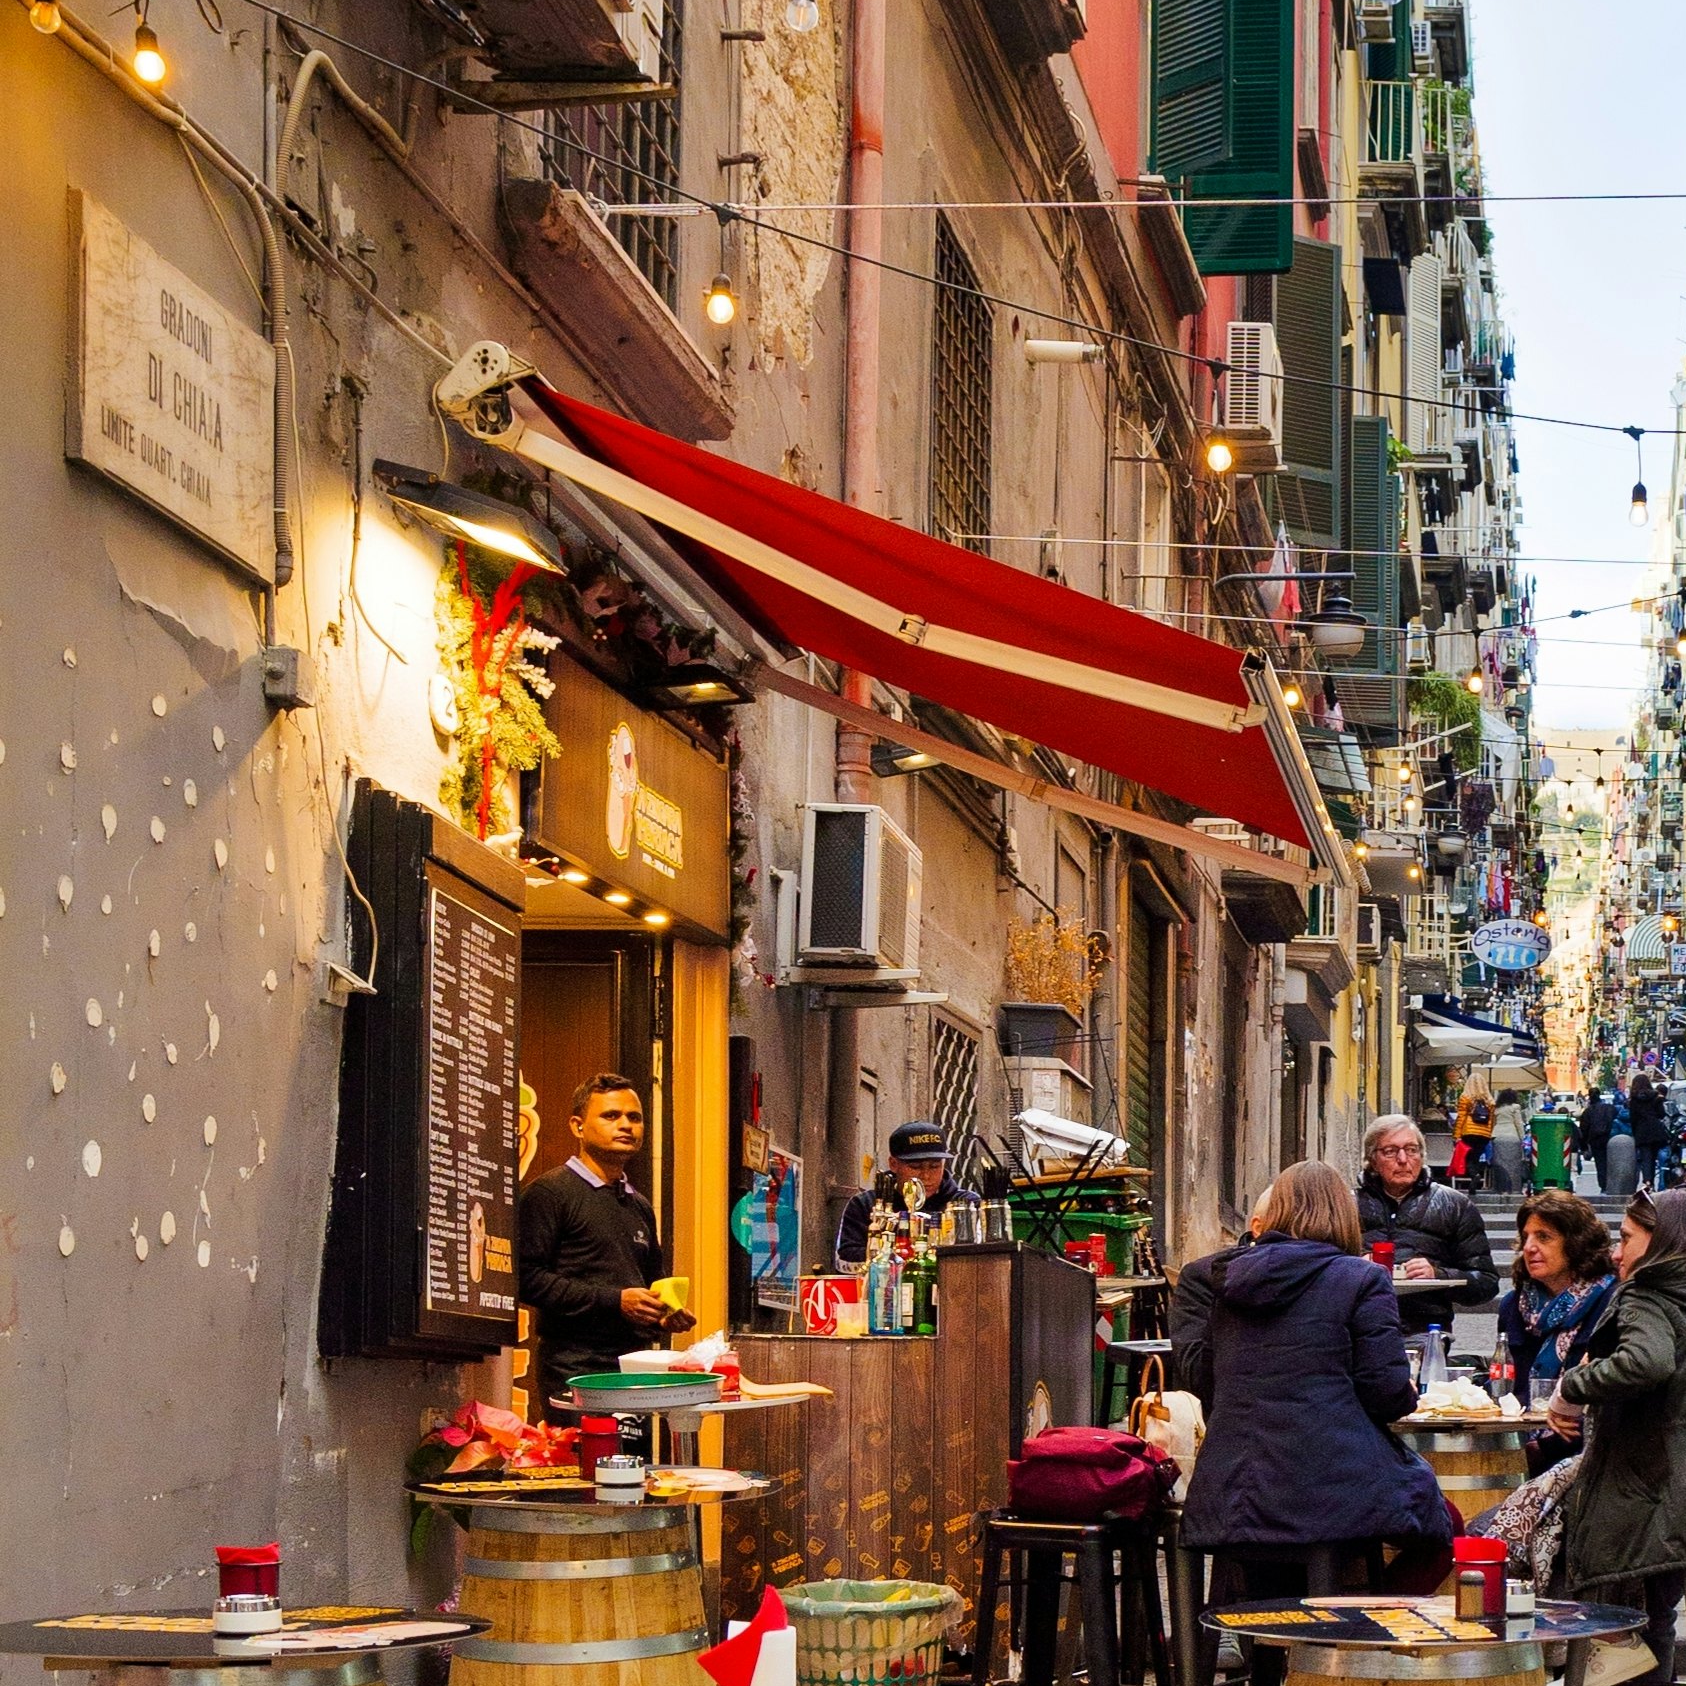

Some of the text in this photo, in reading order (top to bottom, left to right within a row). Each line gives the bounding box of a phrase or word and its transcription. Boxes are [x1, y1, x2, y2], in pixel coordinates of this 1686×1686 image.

[160, 288, 212, 365] GRADONI
[149, 351, 163, 410] DI
[101, 404, 135, 455] LIMITE
[180, 461, 212, 508] CHIAIA
[444, 685, 452, 718] 2
[1473, 922, 1551, 949] Osteria
[909, 1134, 930, 1145] NIKE
[502, 1295, 515, 1311] FREE
